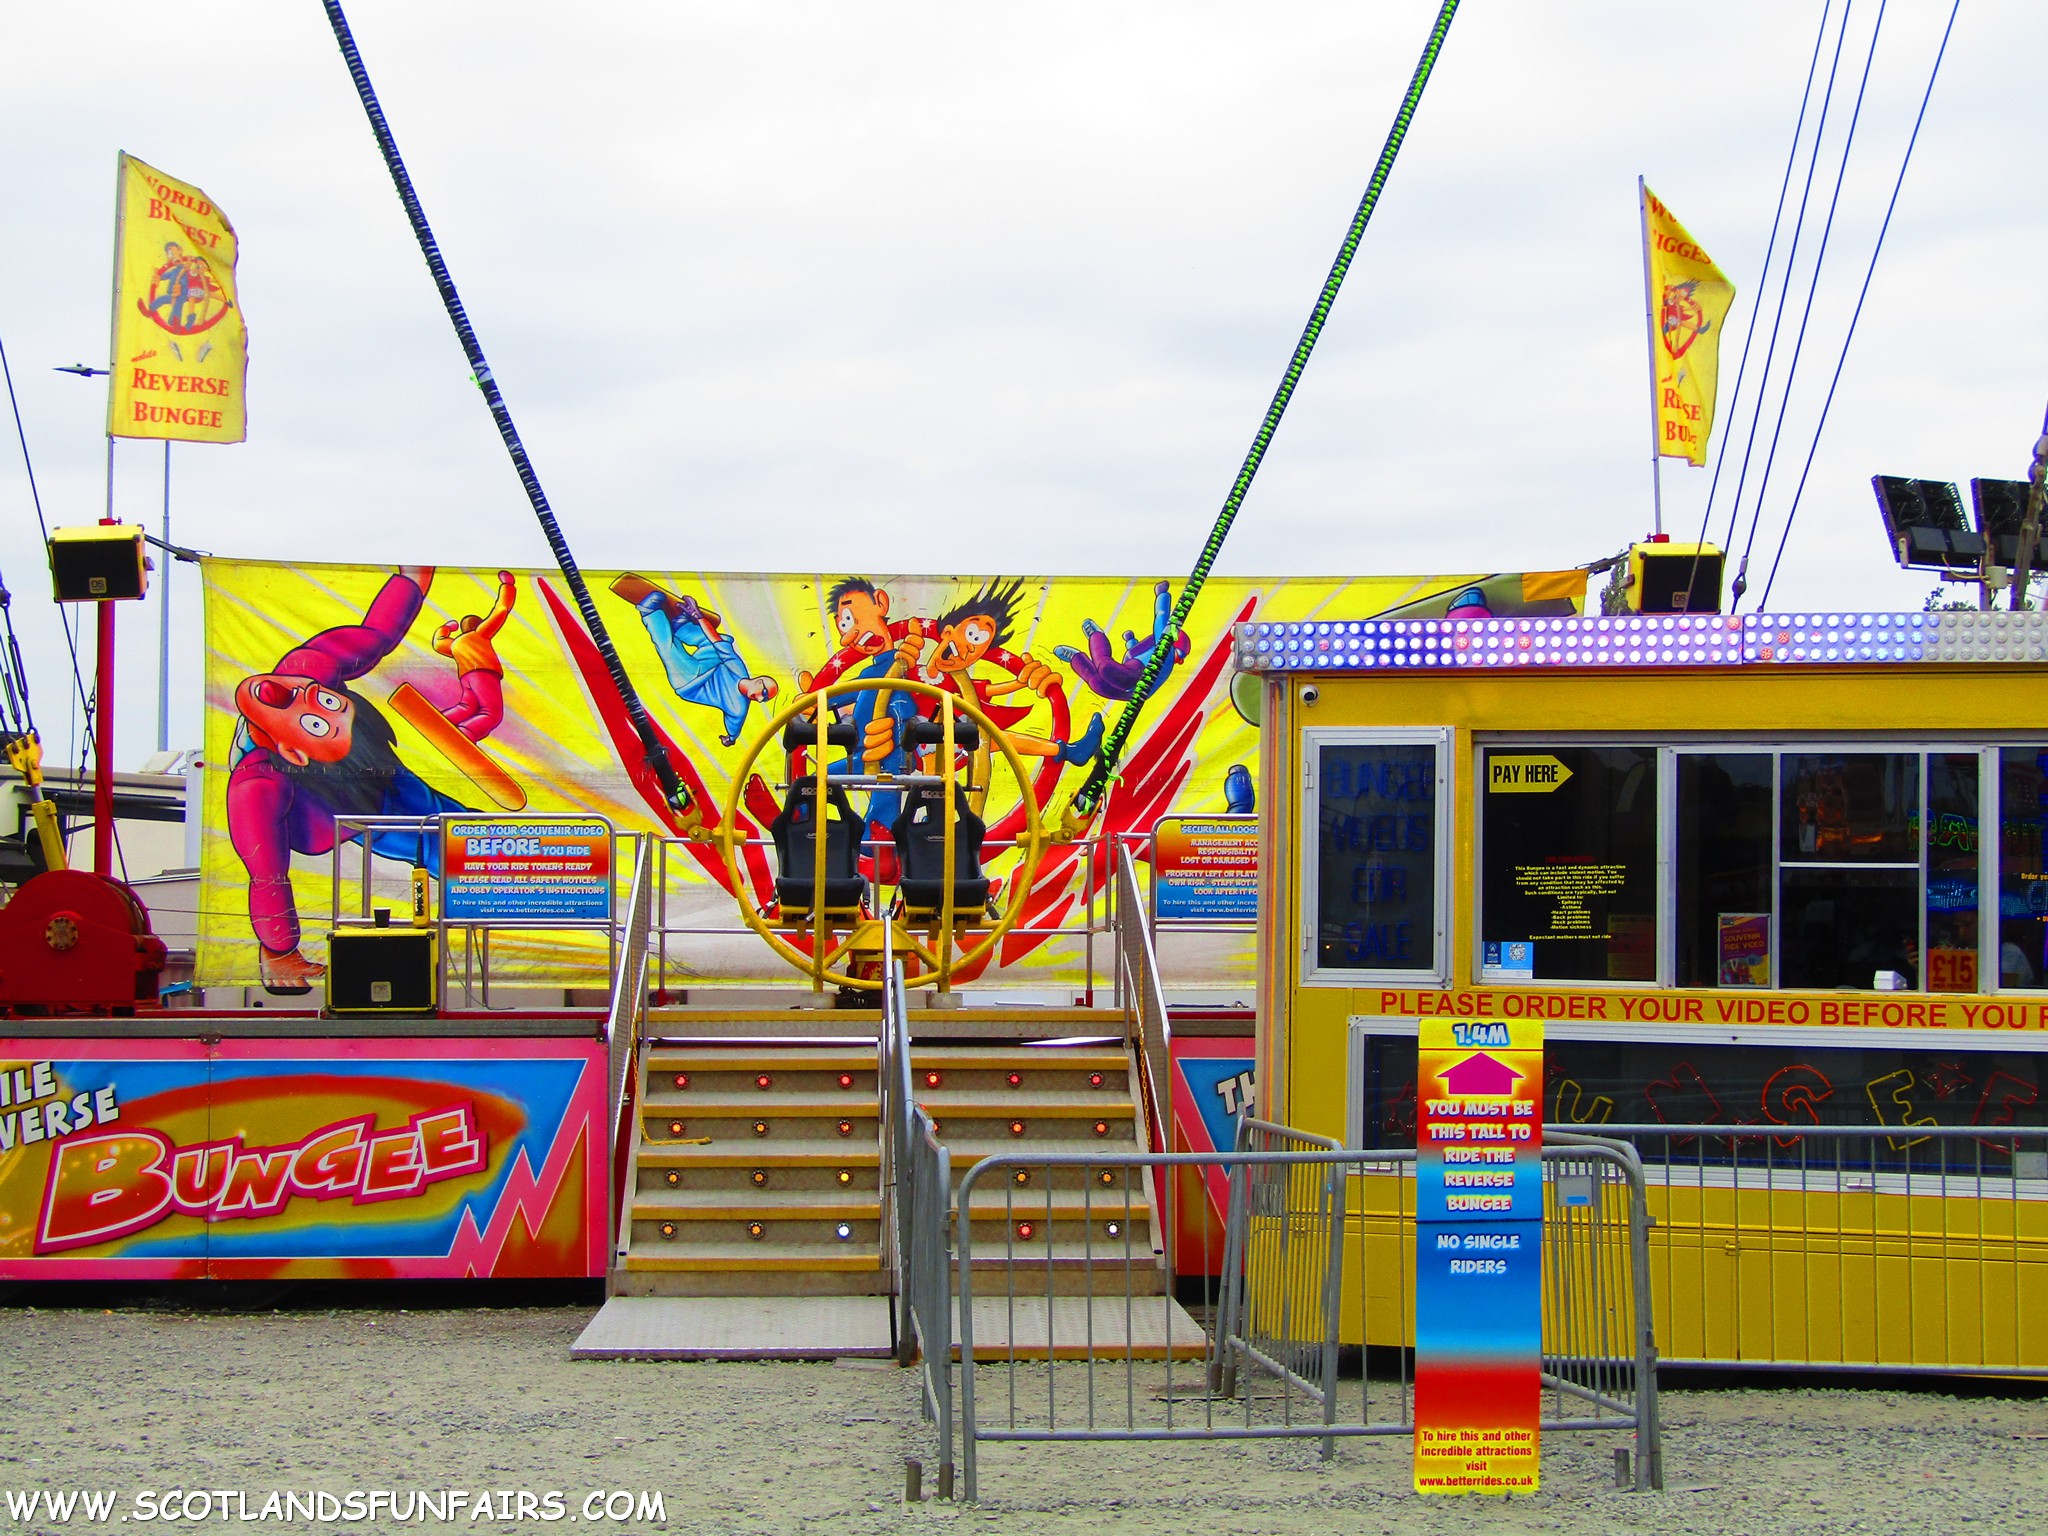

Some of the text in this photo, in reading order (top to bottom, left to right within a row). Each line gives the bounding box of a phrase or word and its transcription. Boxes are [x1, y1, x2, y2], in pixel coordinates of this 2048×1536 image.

[132, 368, 230, 397] REVERSE
[133, 401, 223, 428] BUNGEE
[1493, 765, 1558, 783] PAY HERE
[453, 825, 604, 836] ORDER YOUR SOUVENIR VIDEO
[1181, 825, 1214, 834] SECURE
[1216, 825, 1231, 834] ALL
[466, 838, 590, 856] BEFORE YOU RIDE
[464, 862, 592, 870] HAVE YOUR RIDE TOKENS READY
[459, 876, 597, 884] PLEASE READ ALL SAFETY NOTICES
[1168, 878, 1186, 886] OWN
[1188, 878, 1205, 886] RISK
[1211, 878, 1234, 886] STAFF
[1235, 878, 1250, 886] NOT
[451, 886, 468, 894] AND
[469, 886, 491, 894] OBEY
[545, 886, 605, 894] INSTRUCTIONS
[1346, 921, 1412, 961] SALE
[1743, 941, 1764, 949] VIDEO
[1933, 955, 1973, 983] £15
[1380, 992, 1493, 1017] PLEASE
[1503, 994, 1606, 1019] ORDER
[1619, 996, 1704, 1022] YOUR
[1716, 1000, 1810, 1024] VIDEO
[1820, 1002, 1947, 1028] BEFORE
[1960, 1004, 2027, 1029] YOU
[1454, 1024, 1508, 1044] 1.4M
[1427, 1101, 1533, 1116] YOU MUST BE
[1428, 1125, 1531, 1140] THIS TALL TO
[1444, 1148, 1514, 1163] RIDE THE
[35, 1102, 486, 1254] BUNGEE
[1444, 1172, 1514, 1187] REVERSE
[1447, 1196, 1512, 1211] BUNGEE
[1438, 1235, 1519, 1249] NO SINGLE
[1450, 1260, 1507, 1274] RIDERS
[1422, 1431, 1531, 1441] To hire this and other
[1421, 1446, 1532, 1456] incredible attractions
[1466, 1461, 1487, 1471] visit
[1419, 1475, 1533, 1486] www.betterrides.co.uk
